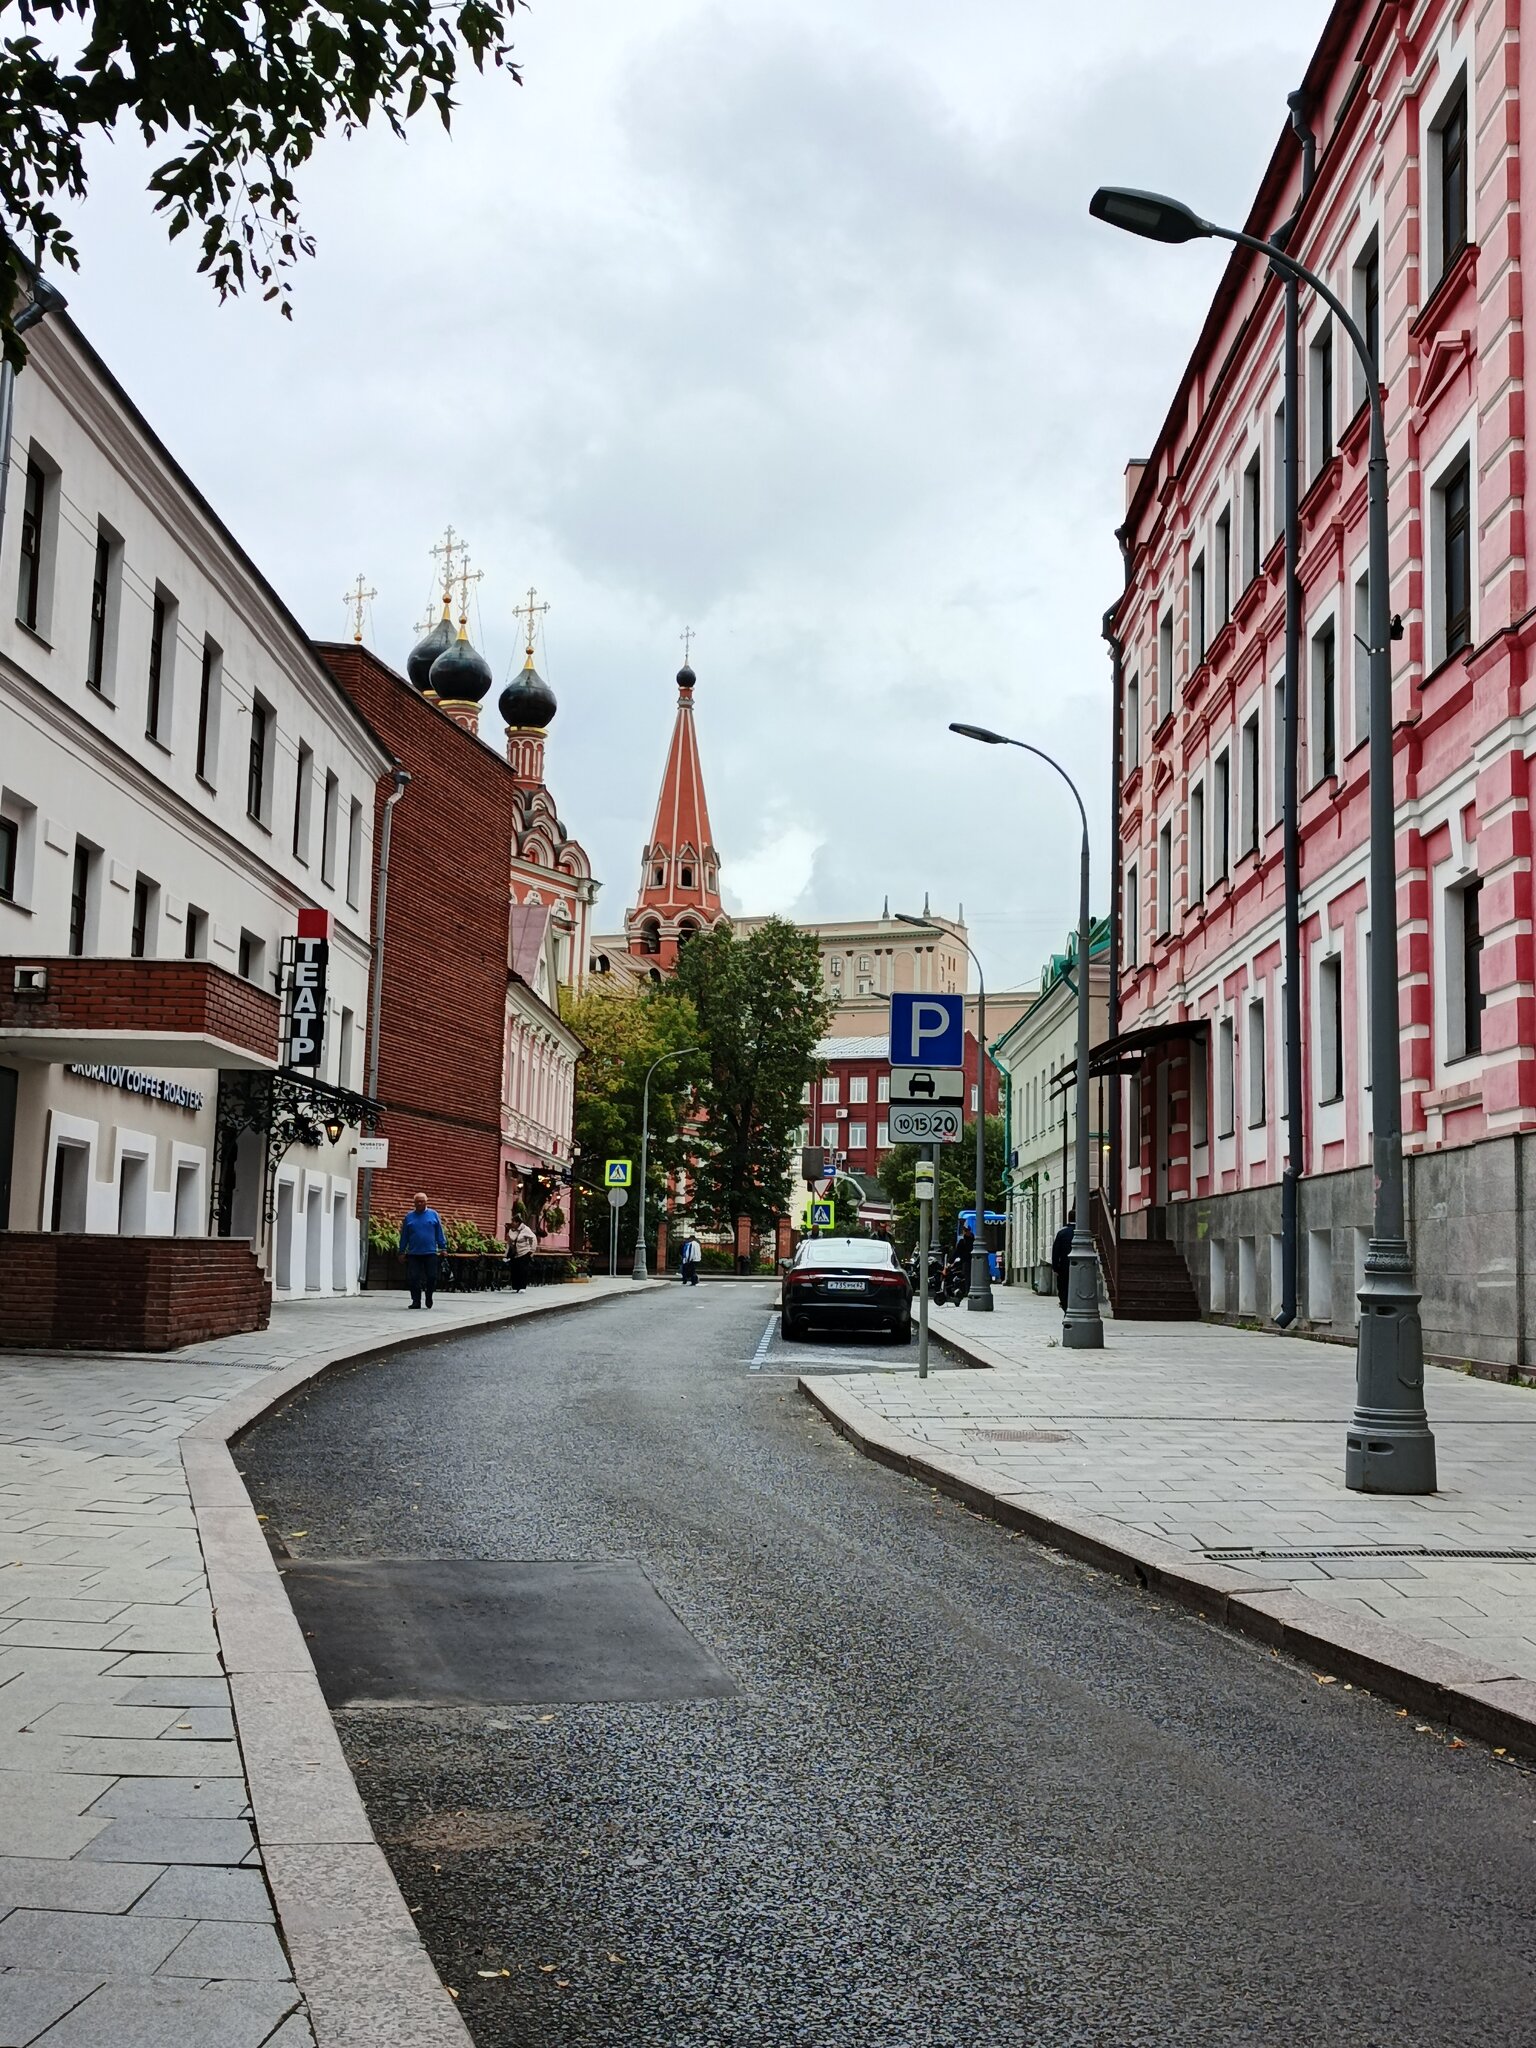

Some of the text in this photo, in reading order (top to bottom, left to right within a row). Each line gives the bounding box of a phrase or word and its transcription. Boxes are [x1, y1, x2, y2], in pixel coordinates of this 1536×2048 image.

[291, 937, 321, 1062] ТЕАТР
[911, 1001, 950, 1057] P
[127, 1070, 162, 1099] COFFEE
[164, 1081, 204, 1110] ROASTERS
[899, 1116, 955, 1133] 10 15 20
